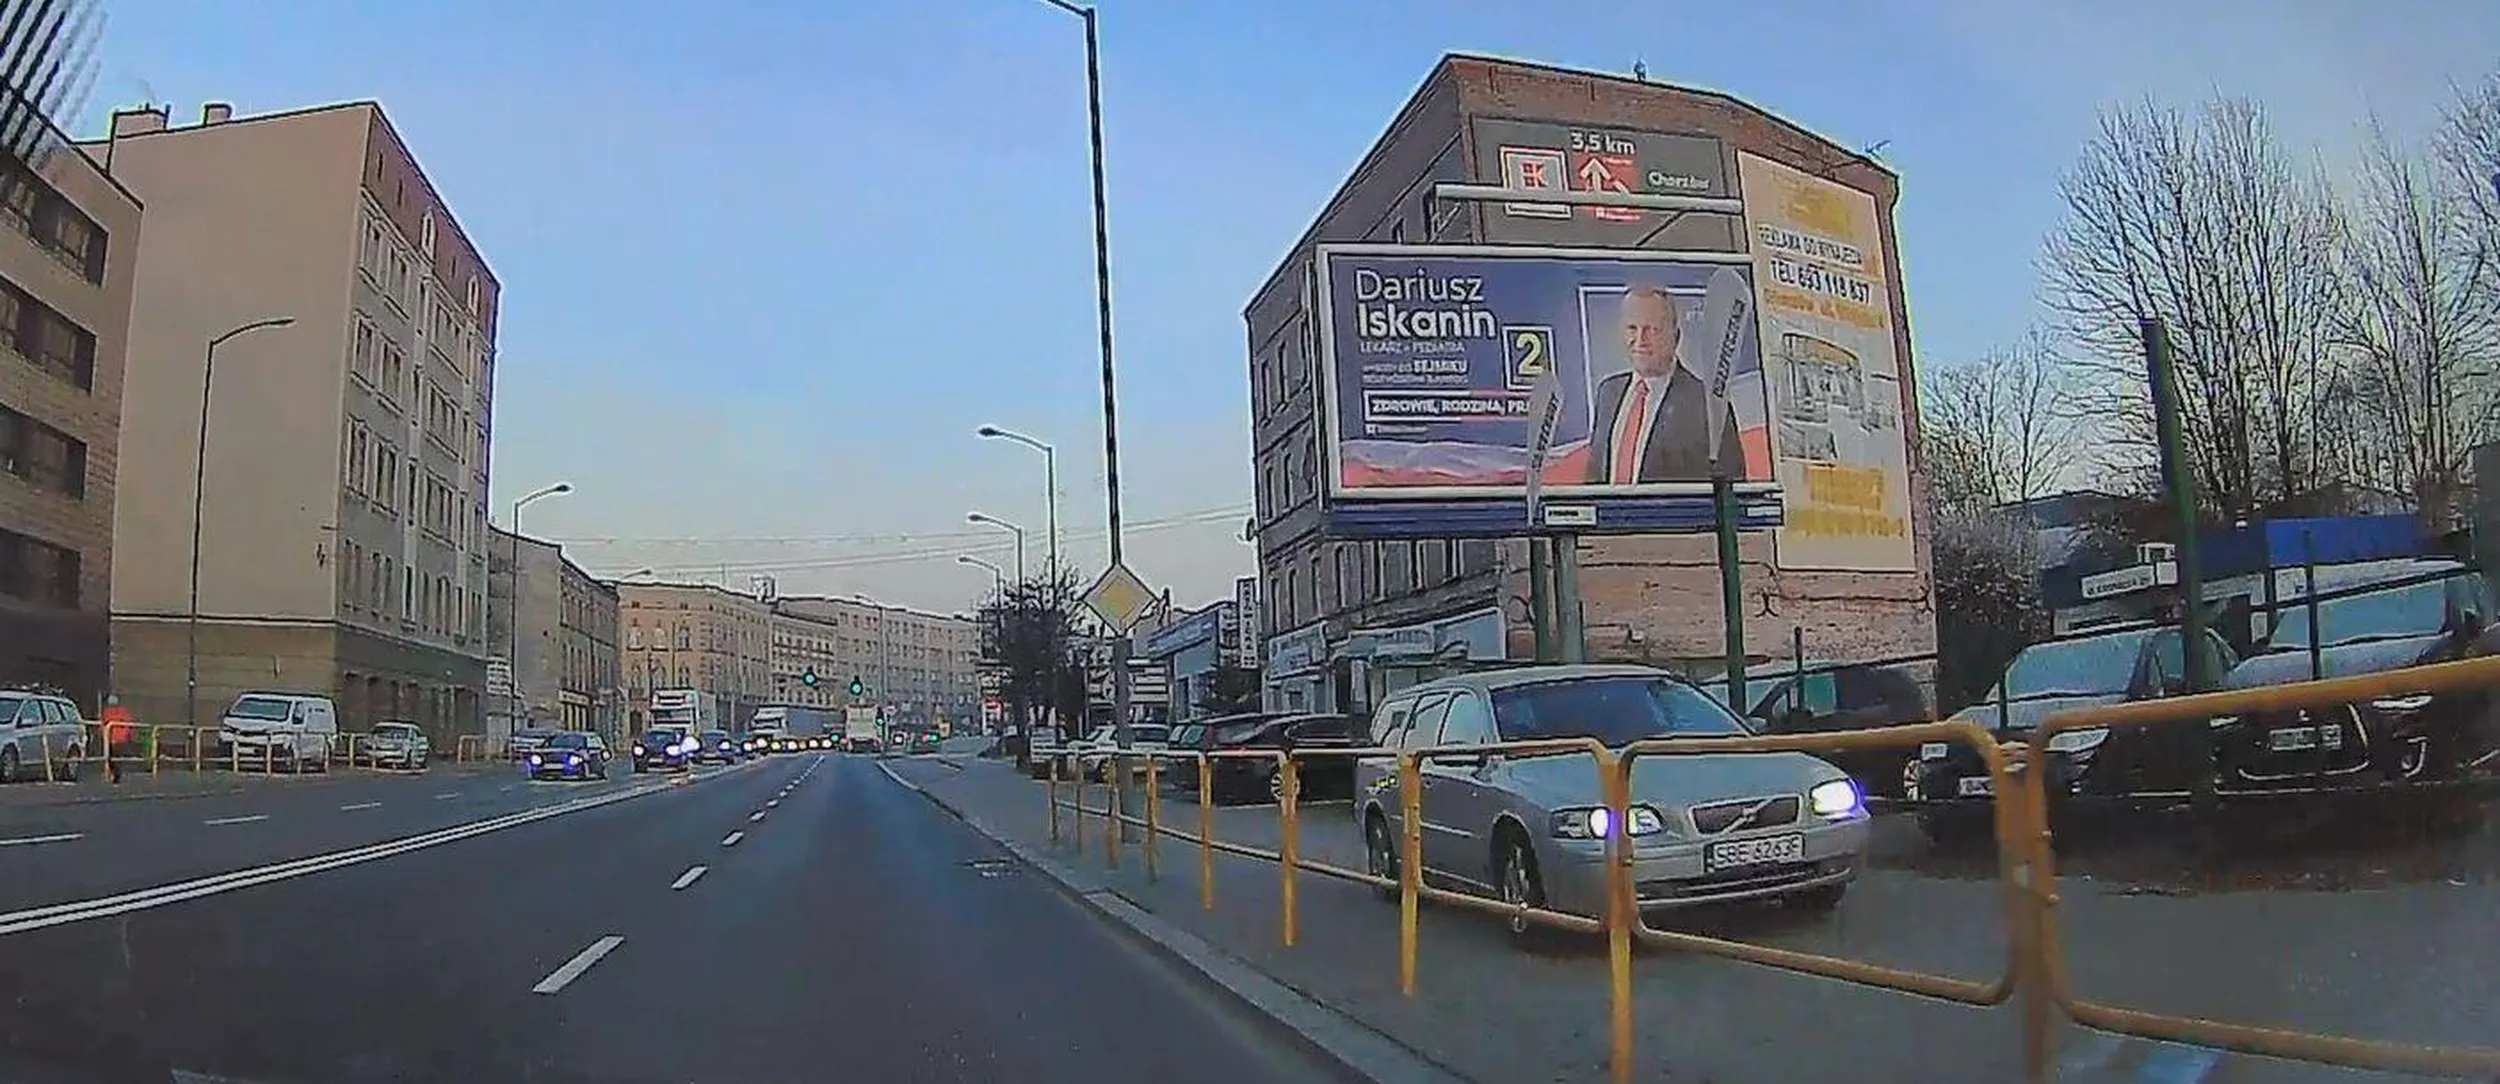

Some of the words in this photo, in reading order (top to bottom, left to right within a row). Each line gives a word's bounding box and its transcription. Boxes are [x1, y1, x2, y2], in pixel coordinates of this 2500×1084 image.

[1571, 132, 1600, 152] 3,5
[1604, 136, 1636, 155] km
[1356, 267, 1484, 301] Dariusz
[1357, 303, 1497, 338] Iskanin
[1516, 332, 1545, 376] 2
[1442, 399, 1505, 416] RODZINA,
